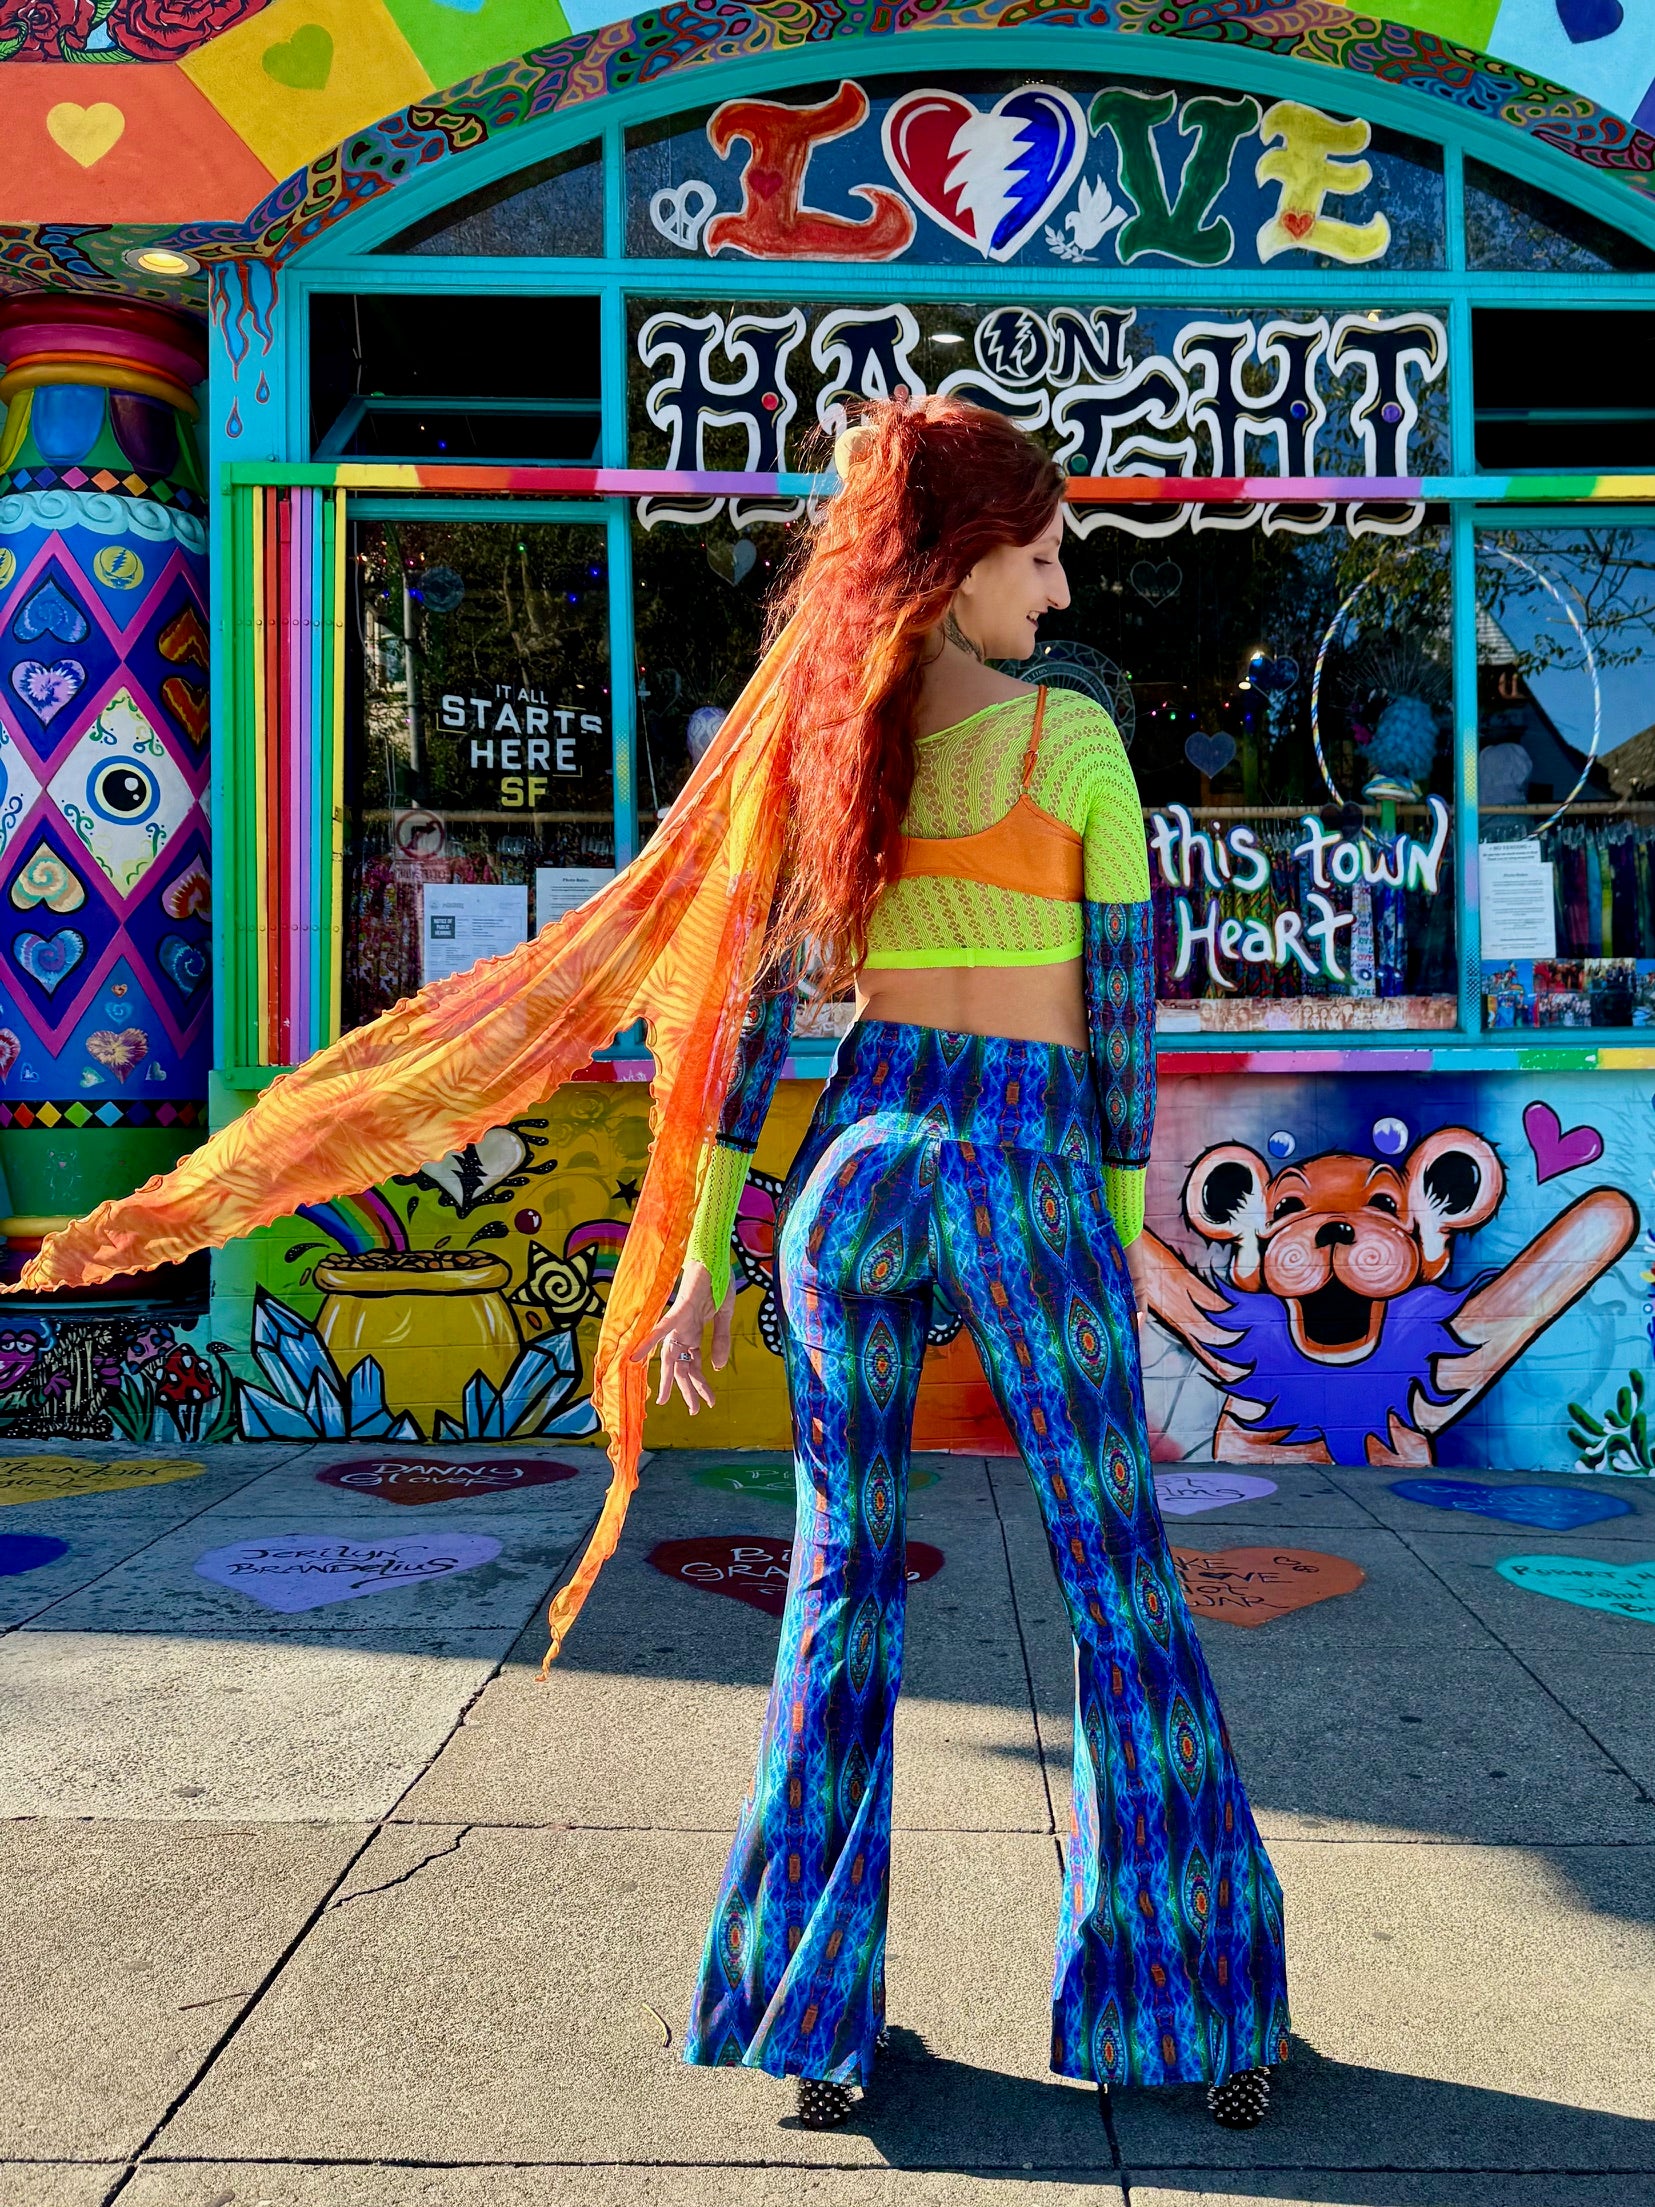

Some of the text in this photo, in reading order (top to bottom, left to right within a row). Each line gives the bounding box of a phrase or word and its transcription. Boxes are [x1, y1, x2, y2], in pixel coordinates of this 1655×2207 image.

[704, 78, 1391, 266] LOVE
[974, 306, 1137, 388] ON
[637, 303, 1448, 540] HAGHT
[442, 694, 603, 735] STARTS
[496, 684, 549, 705] IT ALL
[470, 738, 577, 771] HERE
[501, 776, 548, 807] SF
[1150, 802, 1271, 891] this
